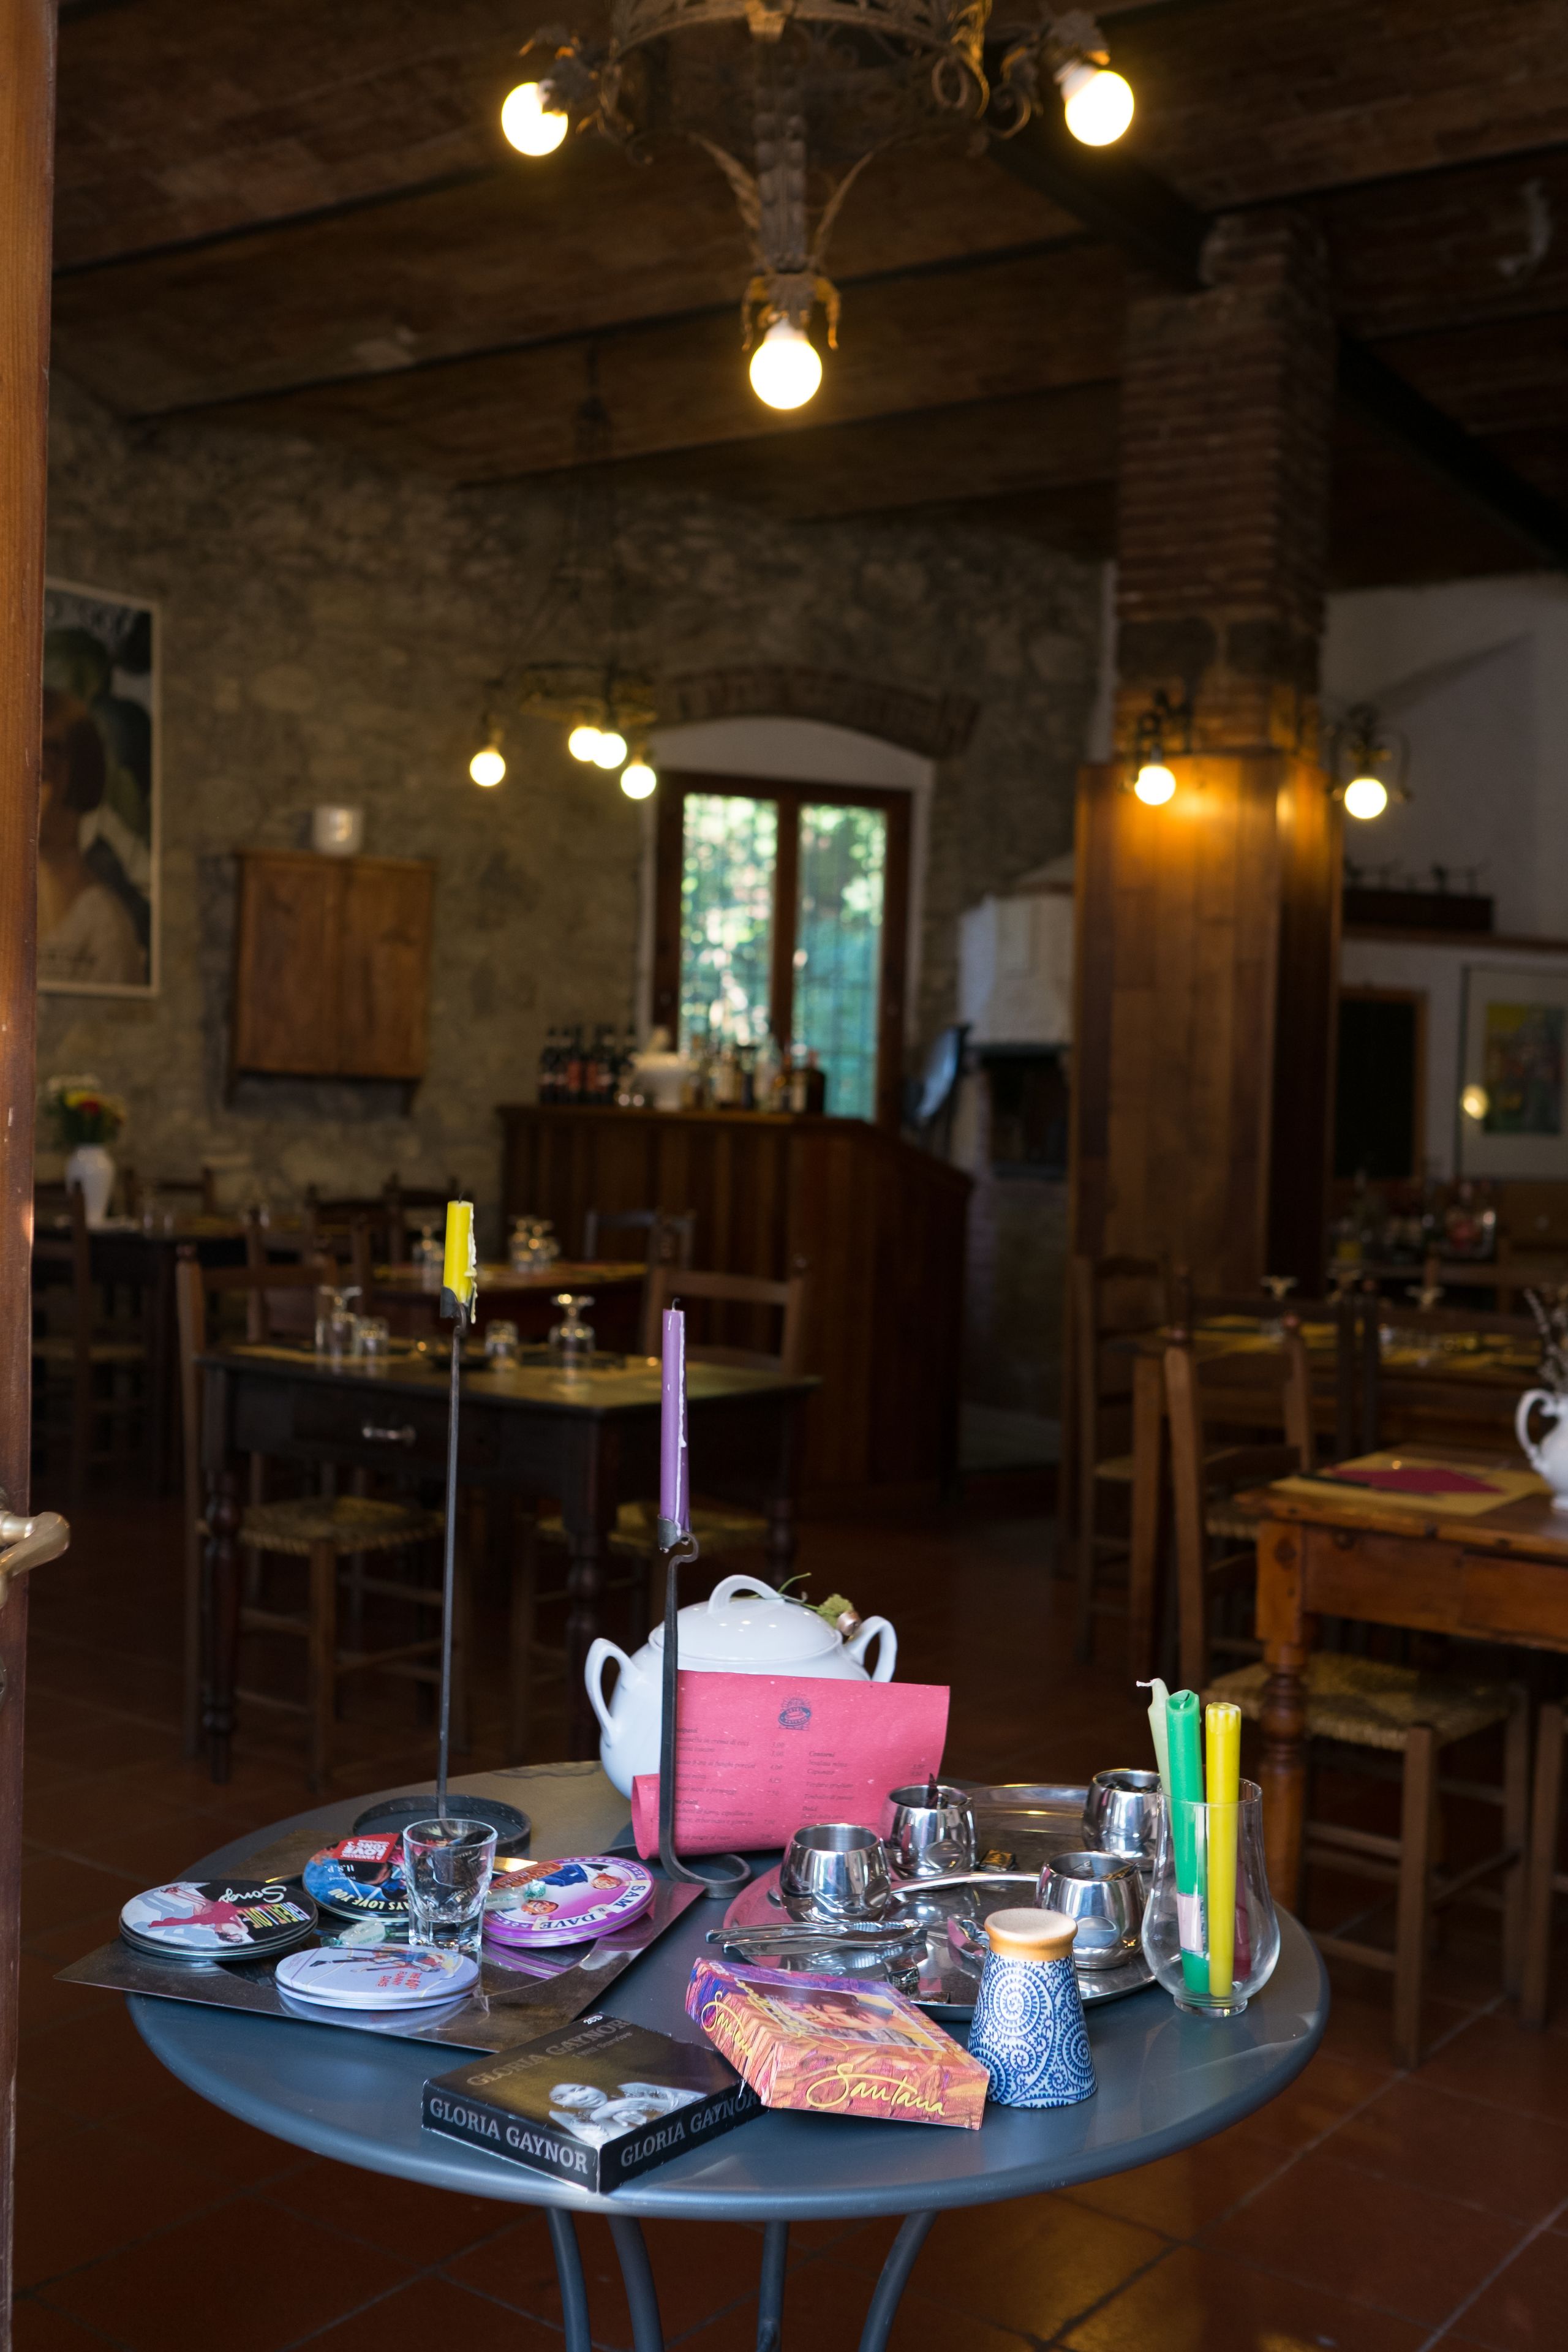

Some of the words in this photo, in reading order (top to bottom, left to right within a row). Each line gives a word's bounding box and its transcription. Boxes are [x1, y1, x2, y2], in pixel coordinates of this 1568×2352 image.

[217, 1885, 287, 1904] Songs
[328, 1888, 355, 1902] YOU
[352, 1897, 385, 1910] LOVE
[614, 1885, 647, 1909] SAM
[237, 1905, 277, 1929] LOVE
[264, 1901, 311, 1925] GREAT
[540, 1913, 597, 1929] DAVE
[583, 2015, 603, 2025] 2CD
[466, 2054, 551, 2086] GLORIA
[545, 2019, 632, 2056] GAYNOR
[806, 2063, 946, 2116] Santana
[429, 2097, 501, 2141] GLORIA
[505, 2125, 589, 2175] GAYNOR
[620, 2124, 686, 2168] GLORIA
[689, 2090, 758, 2135] GAYNOR
